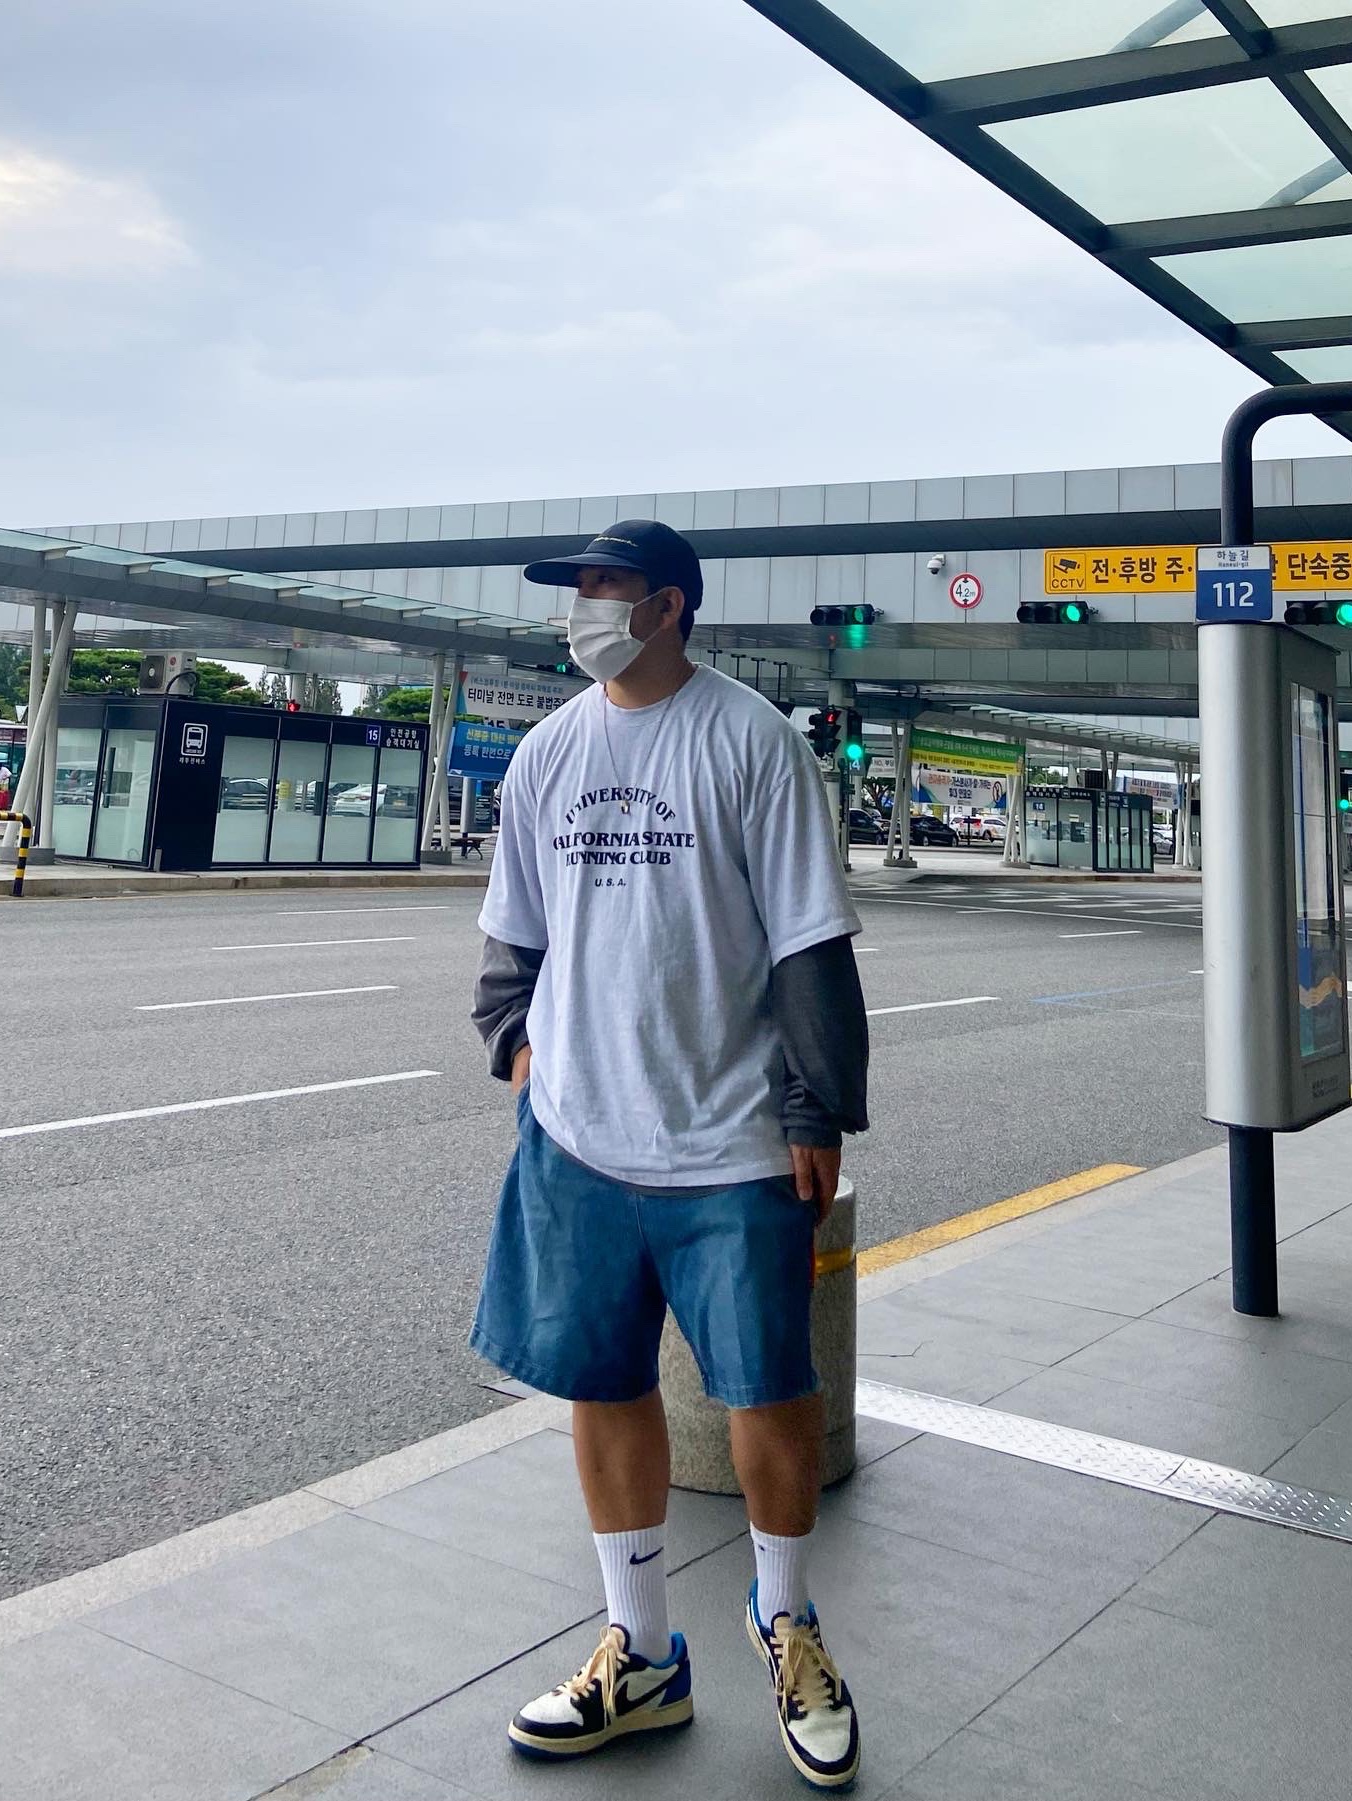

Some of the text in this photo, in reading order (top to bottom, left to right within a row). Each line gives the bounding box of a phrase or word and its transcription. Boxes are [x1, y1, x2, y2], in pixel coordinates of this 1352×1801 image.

[1217, 550, 1249, 561] 하늘길
[1091, 557, 1156, 584] 전·후방
[1288, 552, 1352, 580] 단속중
[1051, 578, 1085, 589] CCTV
[1212, 581, 1254, 607] 112
[468, 688, 494, 704] 터미널
[497, 691, 514, 706] 전면
[516, 693, 534, 707] 도로
[368, 729, 378, 740] 15
[655, 801, 676, 822] OF
[553, 831, 695, 850] CALFORNIA STATE
[630, 850, 672, 865] CLUB
